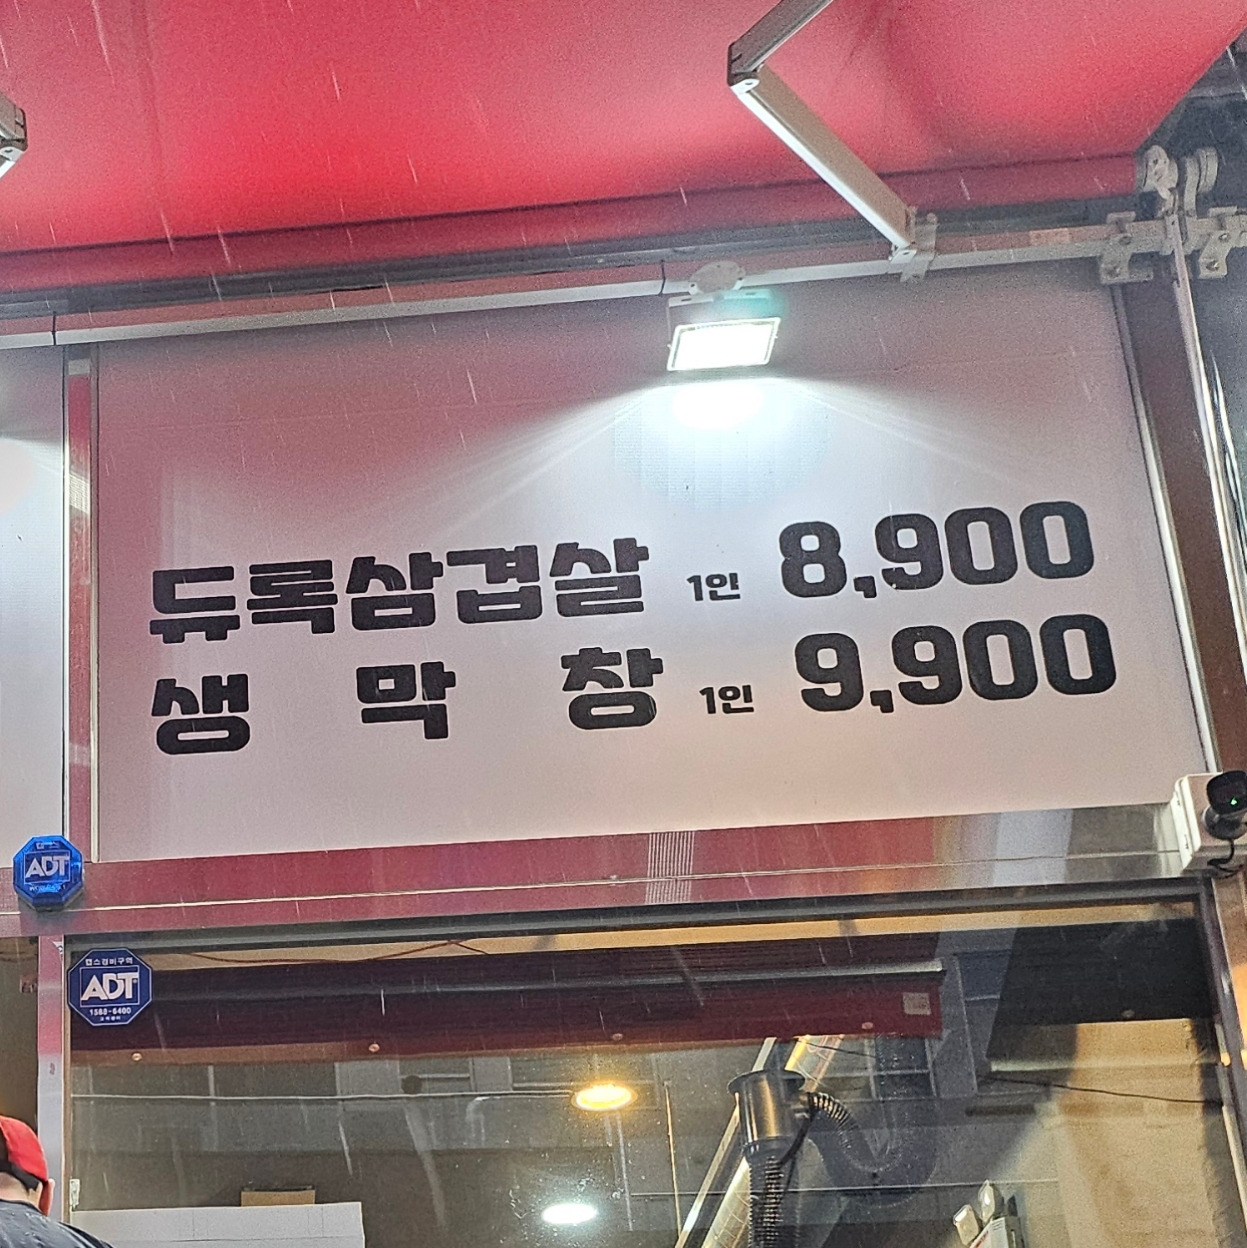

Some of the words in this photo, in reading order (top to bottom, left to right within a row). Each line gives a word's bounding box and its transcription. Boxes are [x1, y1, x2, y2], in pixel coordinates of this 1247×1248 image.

[149, 538, 649, 644] 듀록삼겹살
[687, 572, 741, 601] 1인
[779, 501, 1095, 599] 8,900
[699, 684, 754, 714] 1인
[795, 613, 1117, 714] 9,900
[25, 855, 71, 878] ADT
[81, 972, 140, 1001] ADT
